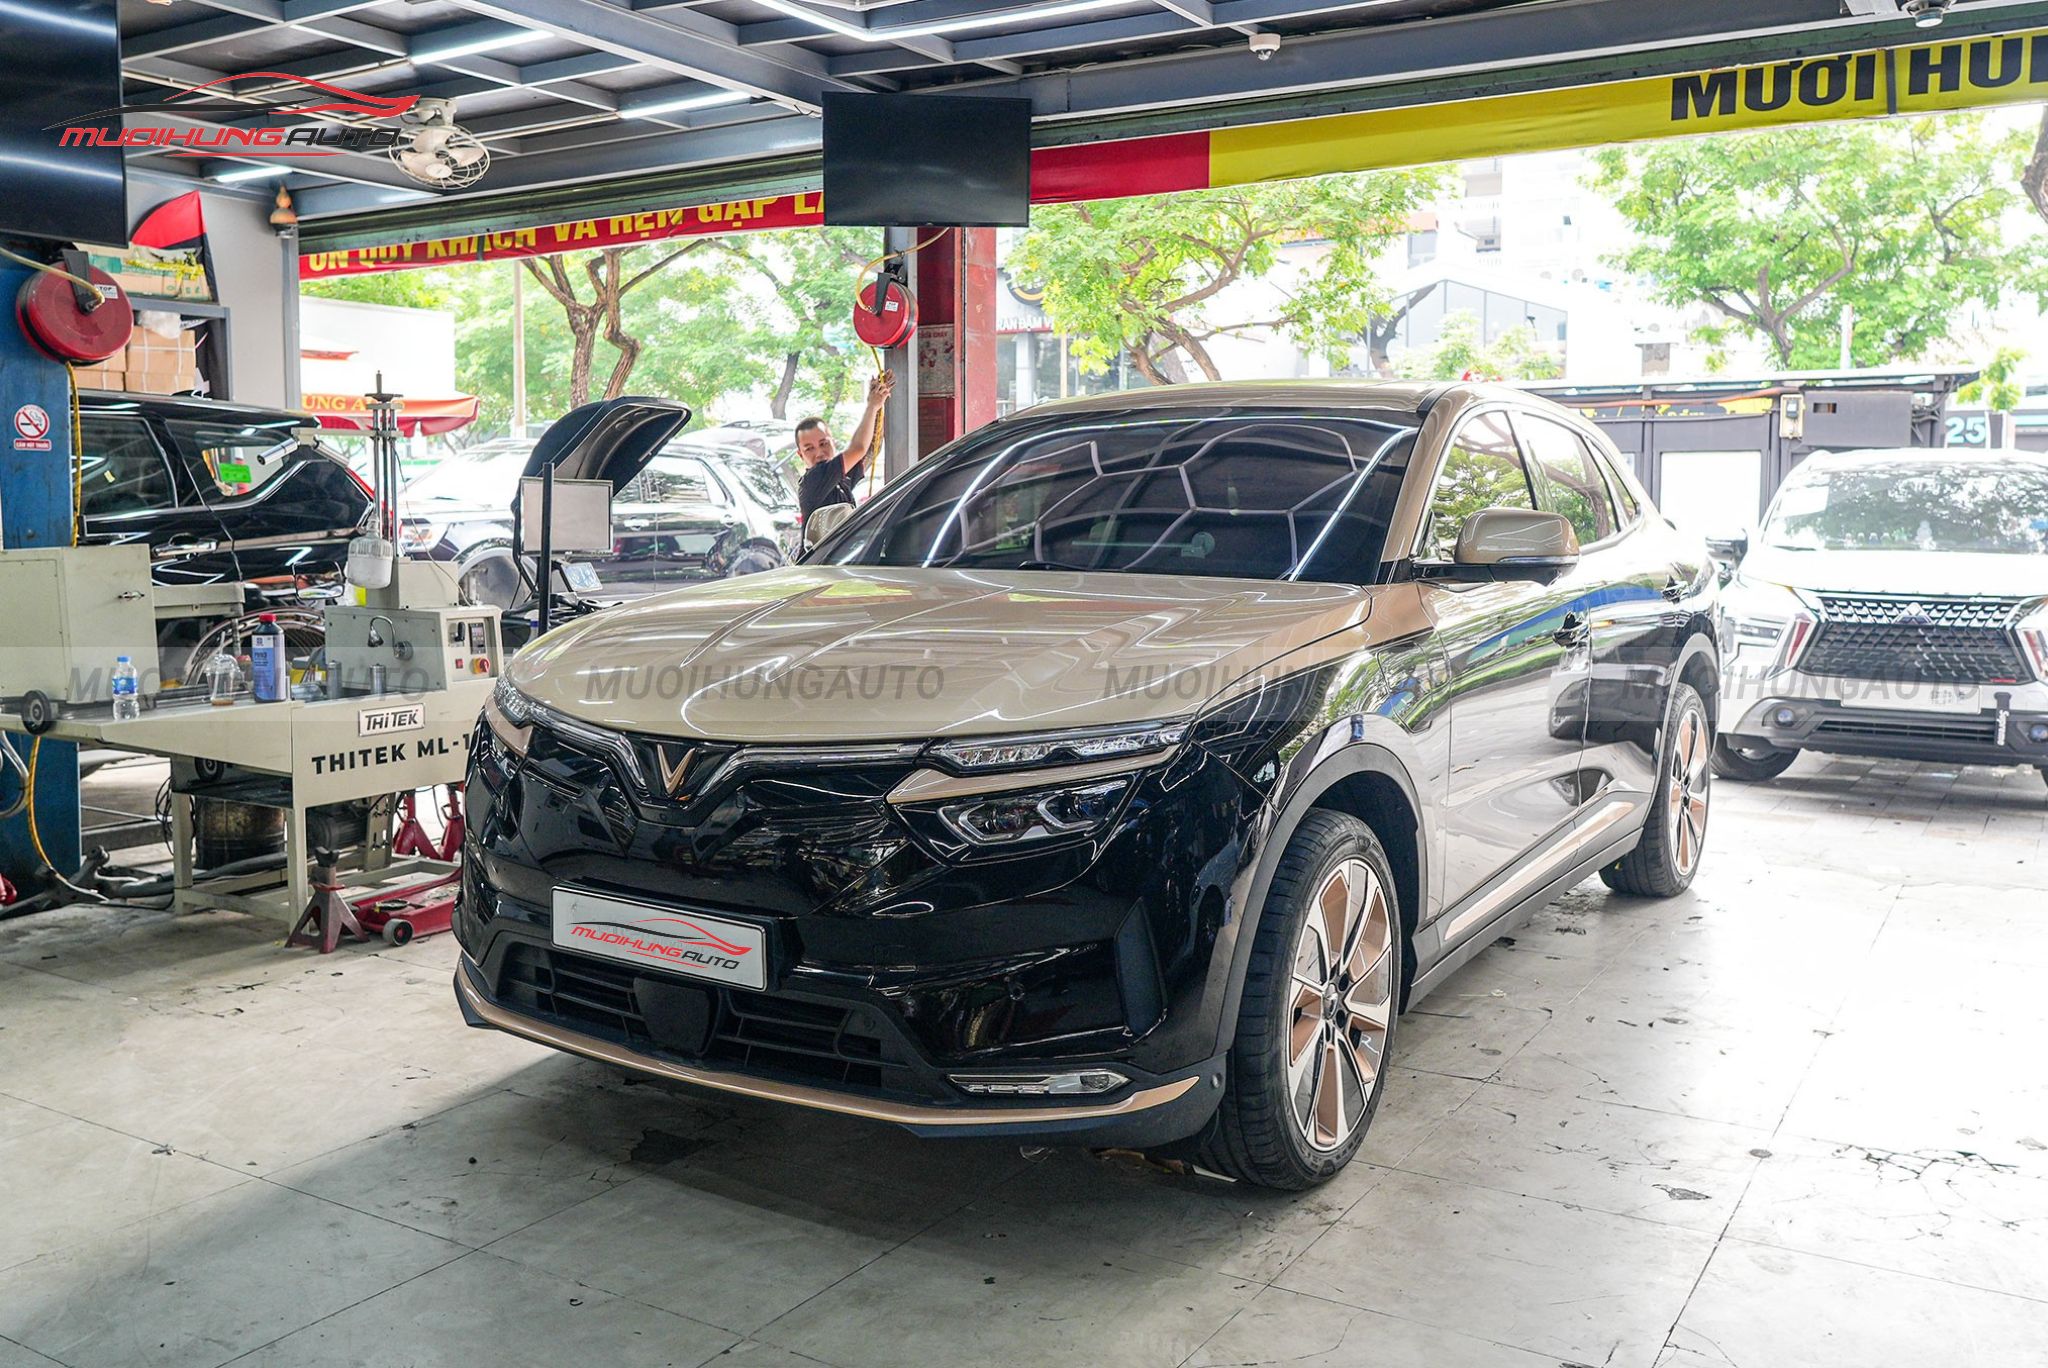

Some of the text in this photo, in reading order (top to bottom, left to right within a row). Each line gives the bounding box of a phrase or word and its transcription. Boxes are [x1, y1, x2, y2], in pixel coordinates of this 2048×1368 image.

[302, 396, 346, 412] UNG
[1945, 417, 1986, 444] 25
[311, 743, 407, 775] THITEK
